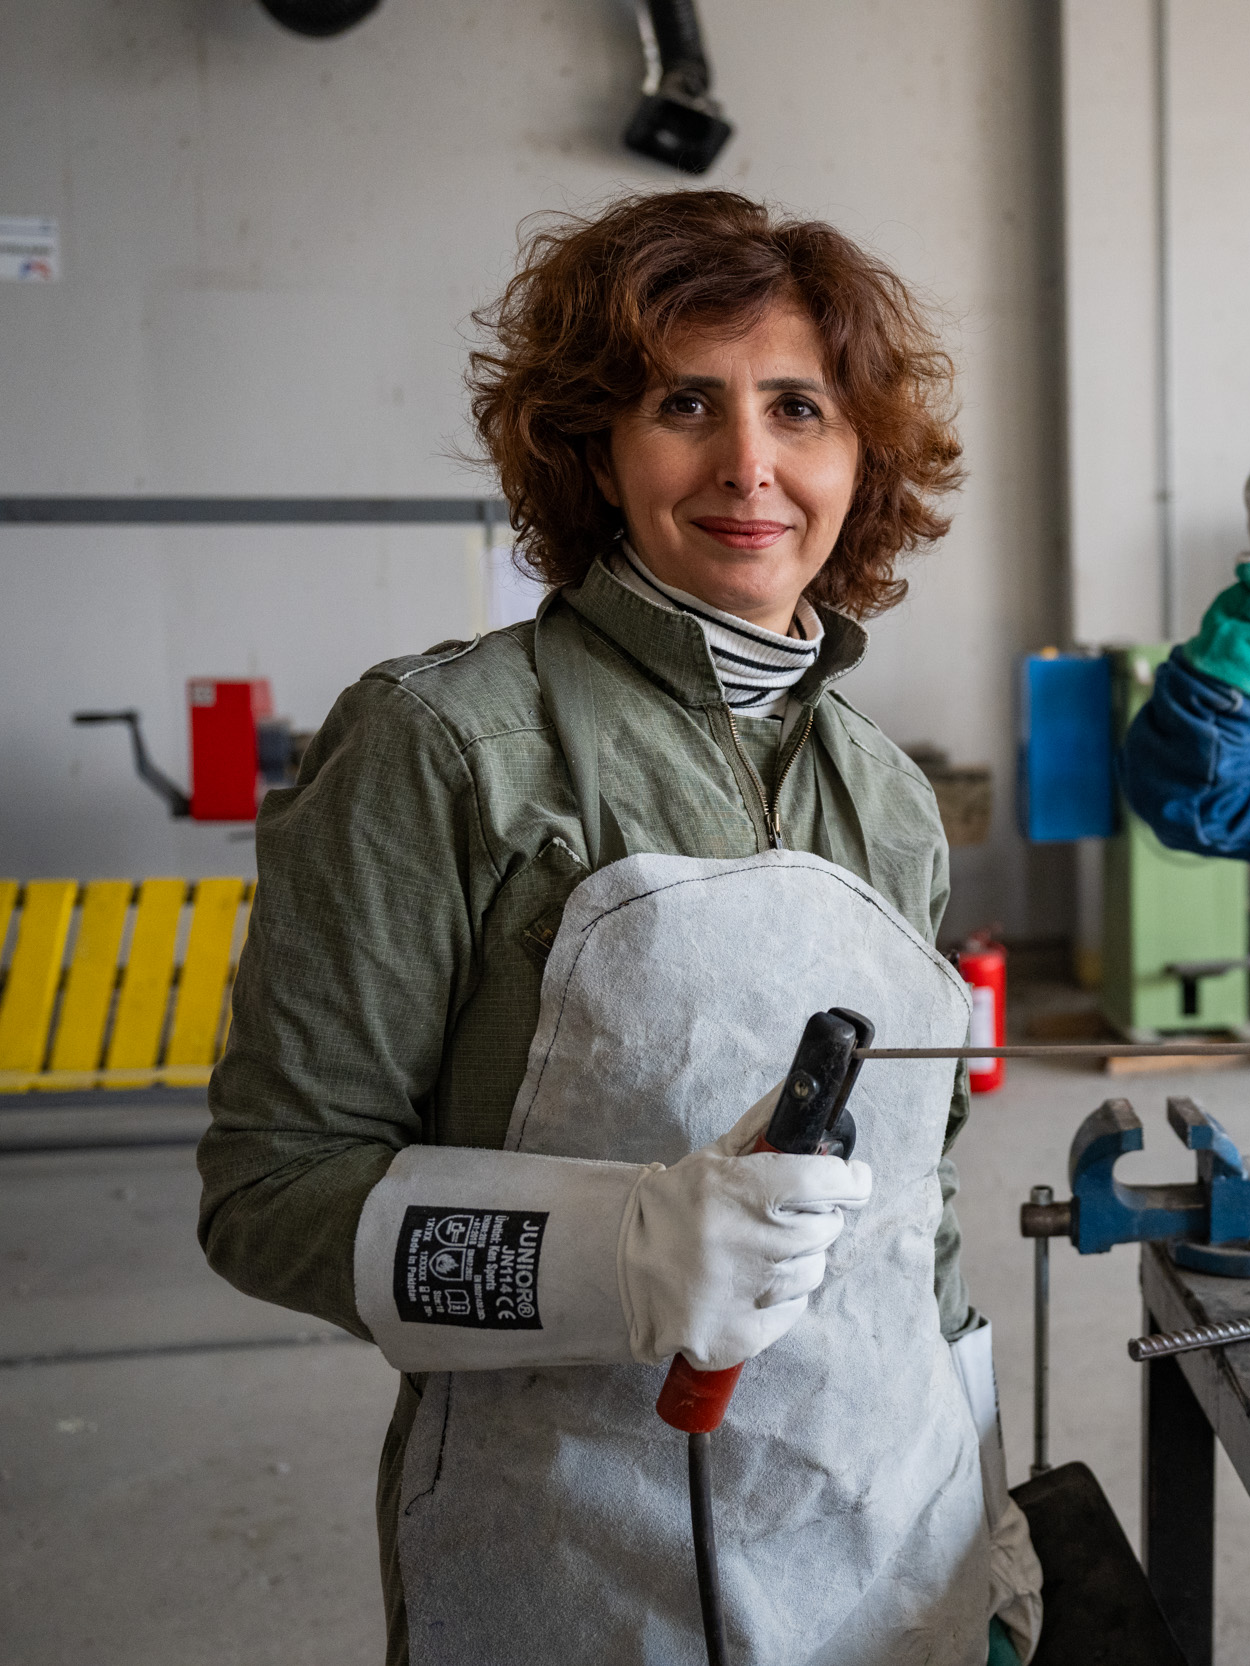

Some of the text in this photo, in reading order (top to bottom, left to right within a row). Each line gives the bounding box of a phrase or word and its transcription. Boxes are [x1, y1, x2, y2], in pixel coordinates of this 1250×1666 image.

[422, 1217, 436, 1242] 1X1XX
[407, 1229, 422, 1302] Made in Pakistan
[487, 1245, 500, 1262] Ken
[484, 1263, 498, 1291] Sports
[500, 1245, 515, 1293] JN114
